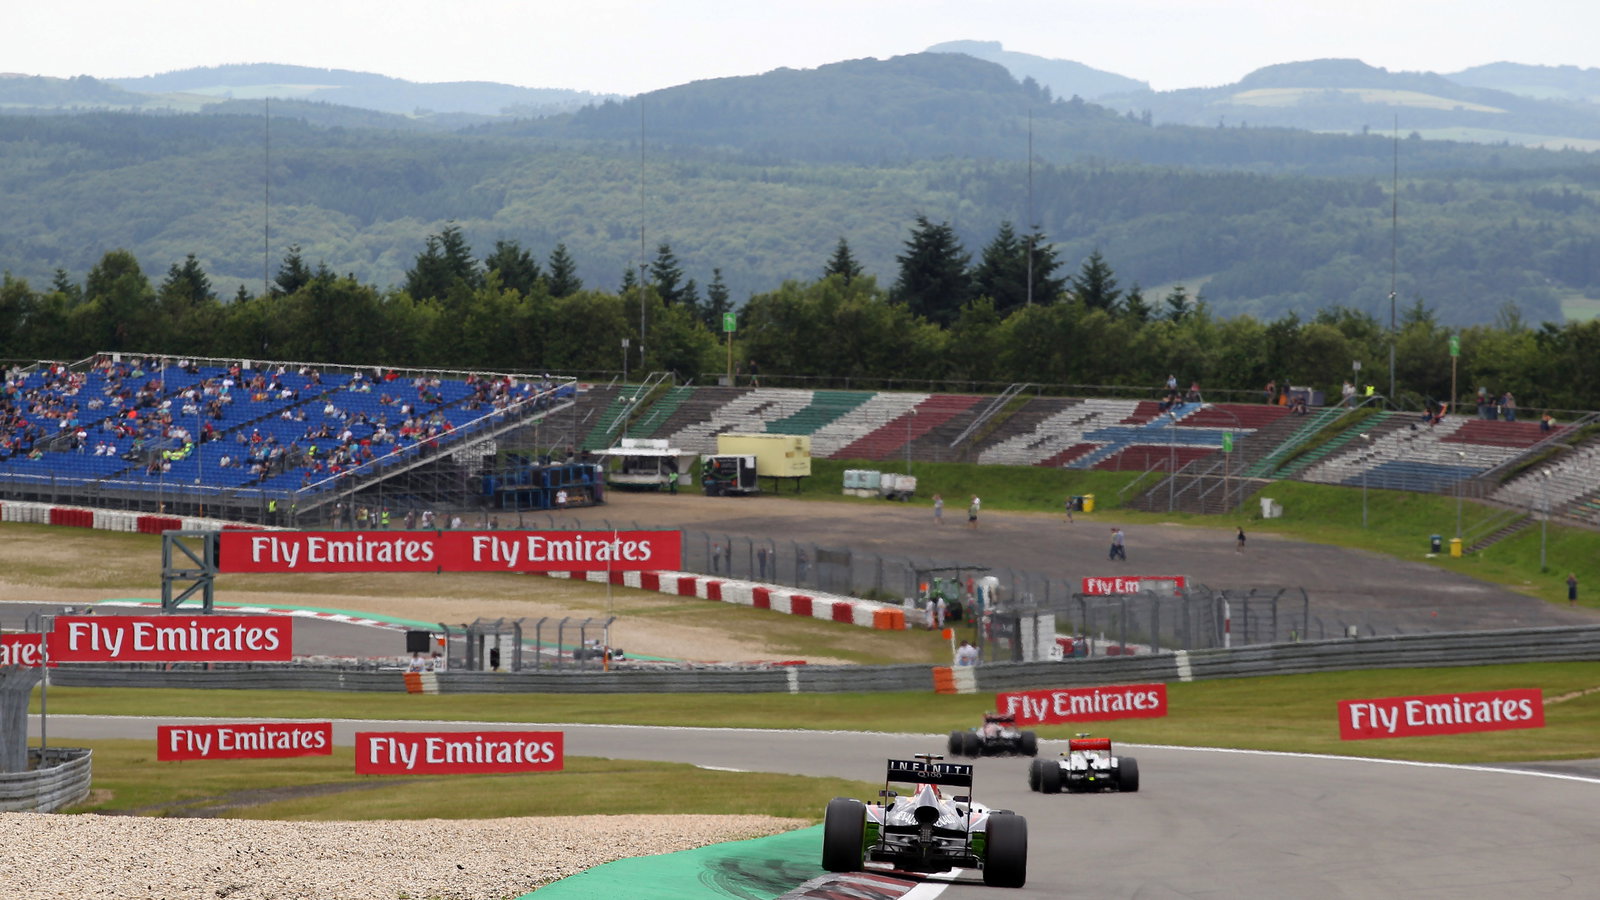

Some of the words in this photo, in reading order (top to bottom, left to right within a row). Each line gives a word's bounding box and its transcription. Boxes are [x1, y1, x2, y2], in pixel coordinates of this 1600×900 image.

[252, 537, 299, 568] Fly
[308, 535, 434, 563] Emirates
[473, 536, 520, 568] Fly
[527, 535, 652, 562] Emirates
[1087, 578, 1113, 595] Fly
[69, 622, 124, 658] Fly
[133, 621, 279, 651] Emirates
[1006, 695, 1049, 722] Fly
[1052, 689, 1159, 717] Emirates
[1349, 703, 1399, 735] Fly
[1405, 697, 1533, 727] Emirates
[170, 728, 212, 757] Fly
[218, 726, 326, 752] Emirates
[370, 737, 419, 769] Fly
[425, 736, 555, 765] Emirates
[890, 761, 970, 775] INFINITI
